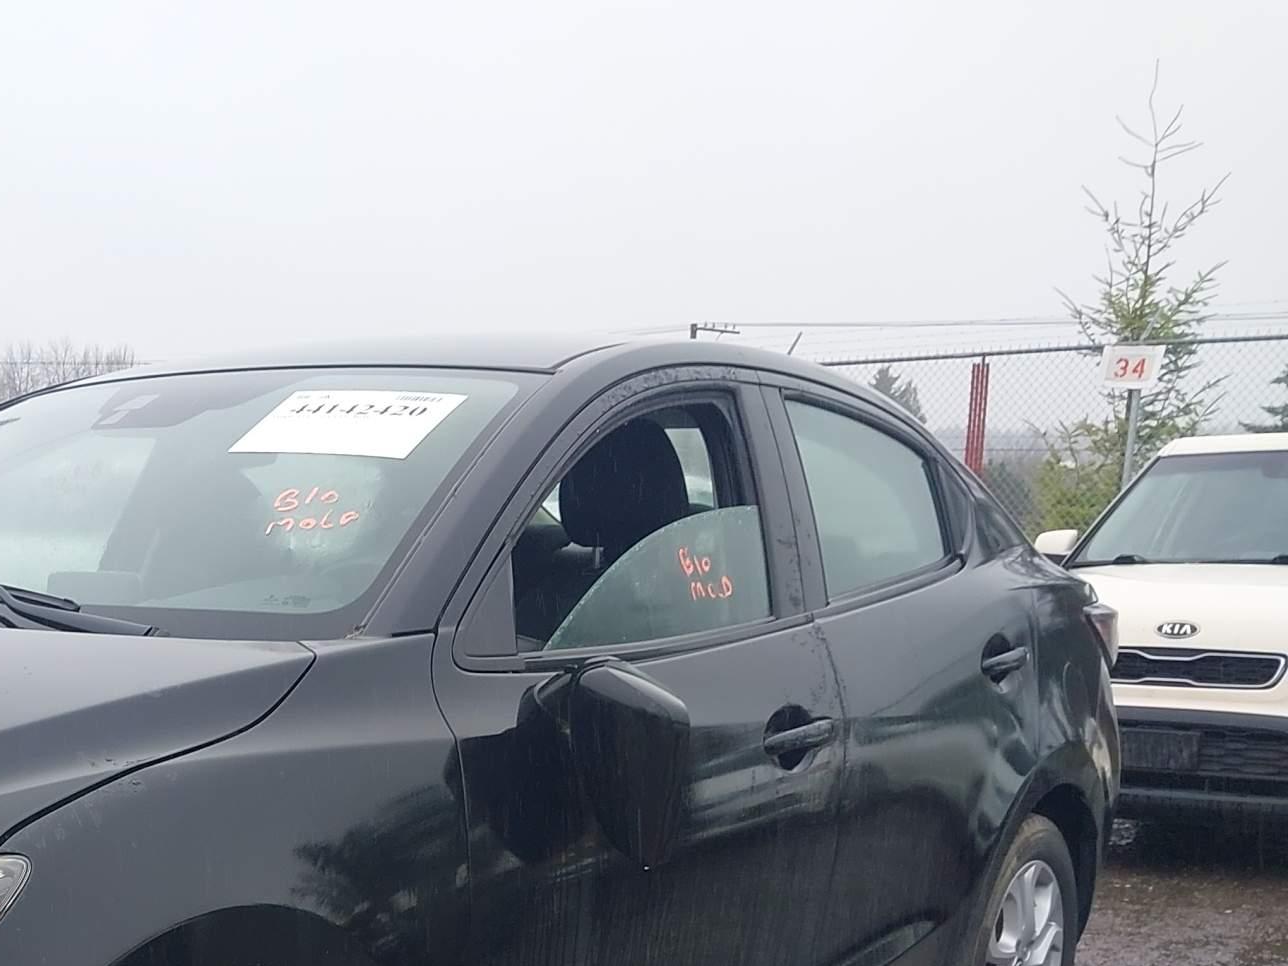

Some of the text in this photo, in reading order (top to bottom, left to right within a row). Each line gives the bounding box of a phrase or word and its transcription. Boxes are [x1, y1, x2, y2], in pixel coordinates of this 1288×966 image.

[1114, 357, 1146, 379] 34
[290, 402, 428, 417] 44142420
[1161, 623, 1192, 635] KIA
